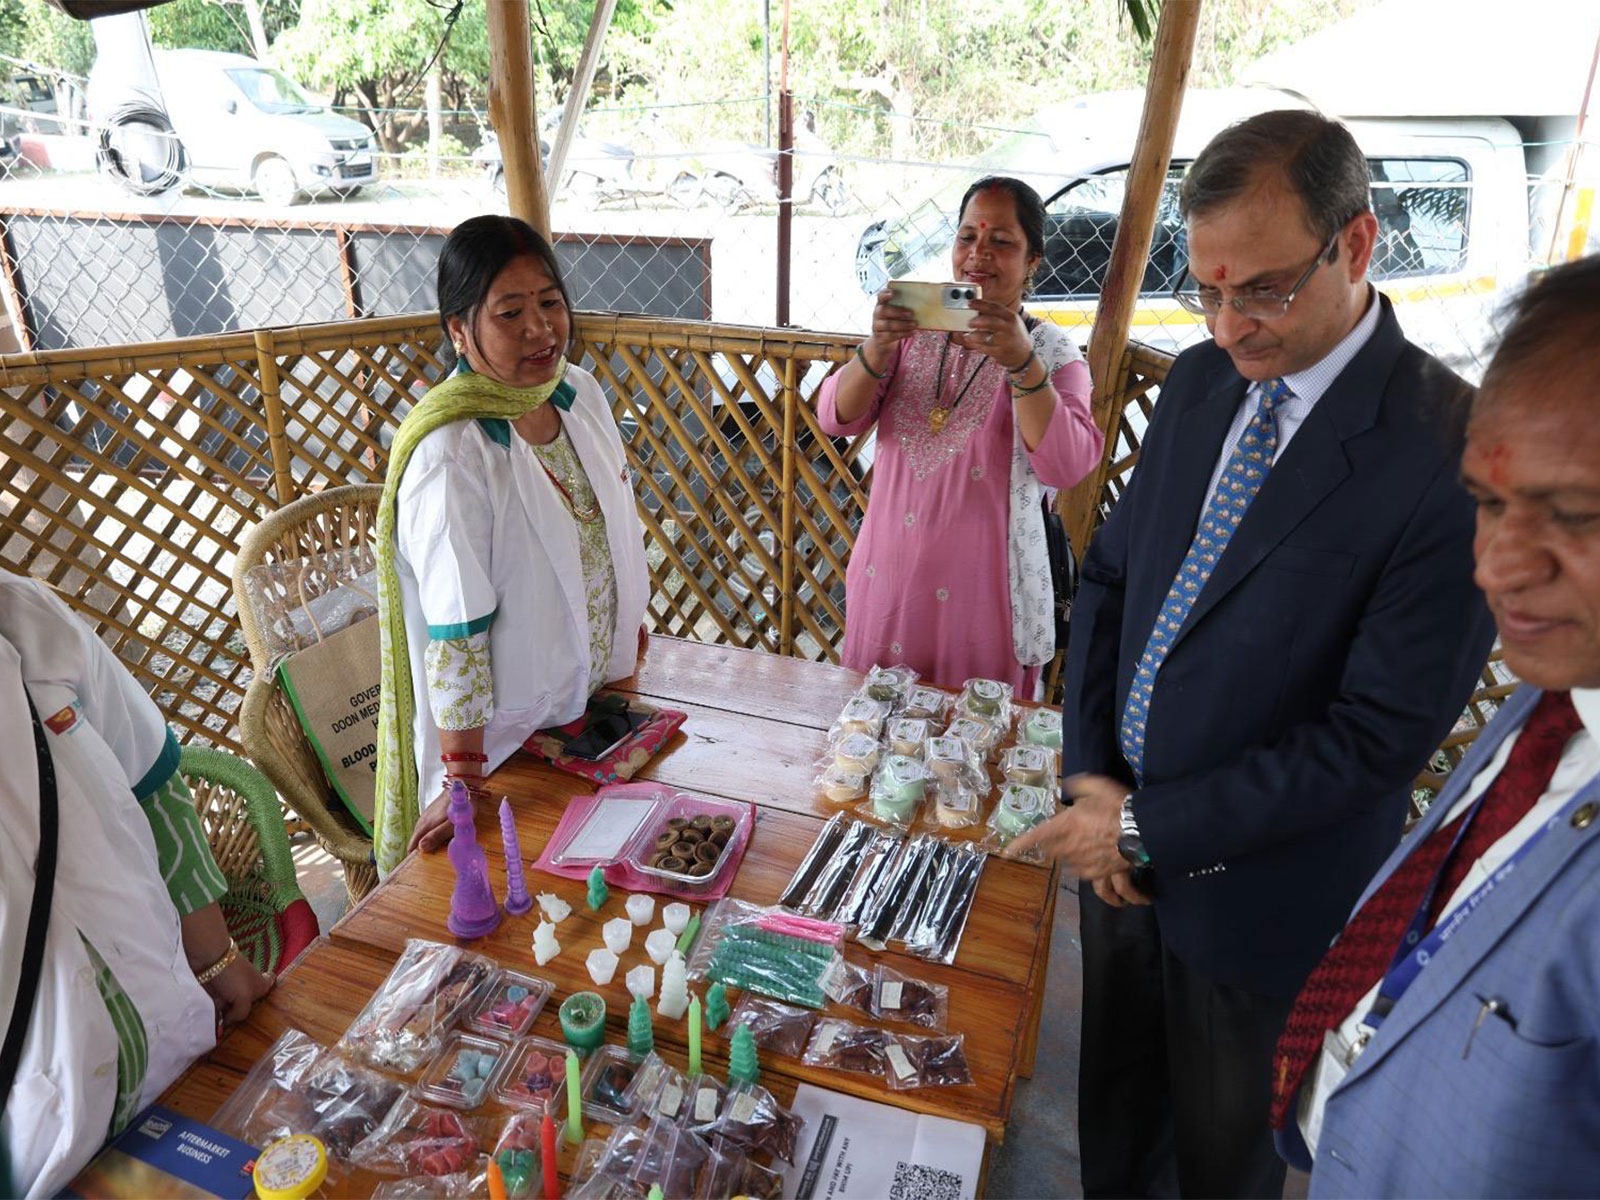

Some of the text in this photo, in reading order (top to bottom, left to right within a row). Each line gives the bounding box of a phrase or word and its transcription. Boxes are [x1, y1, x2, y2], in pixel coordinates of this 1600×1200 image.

[332, 713, 360, 734] DOON
[359, 701, 380, 719] MED
[341, 743, 376, 768] BLOOD
[176, 1143, 213, 1164] BUSINESS
[177, 1131, 231, 1158] AFTERMARKET
[842, 1137, 850, 1151] ANY
[836, 1151, 846, 1168] WITH
[831, 1168, 840, 1181] PAY
[827, 1181, 837, 1196] AND
